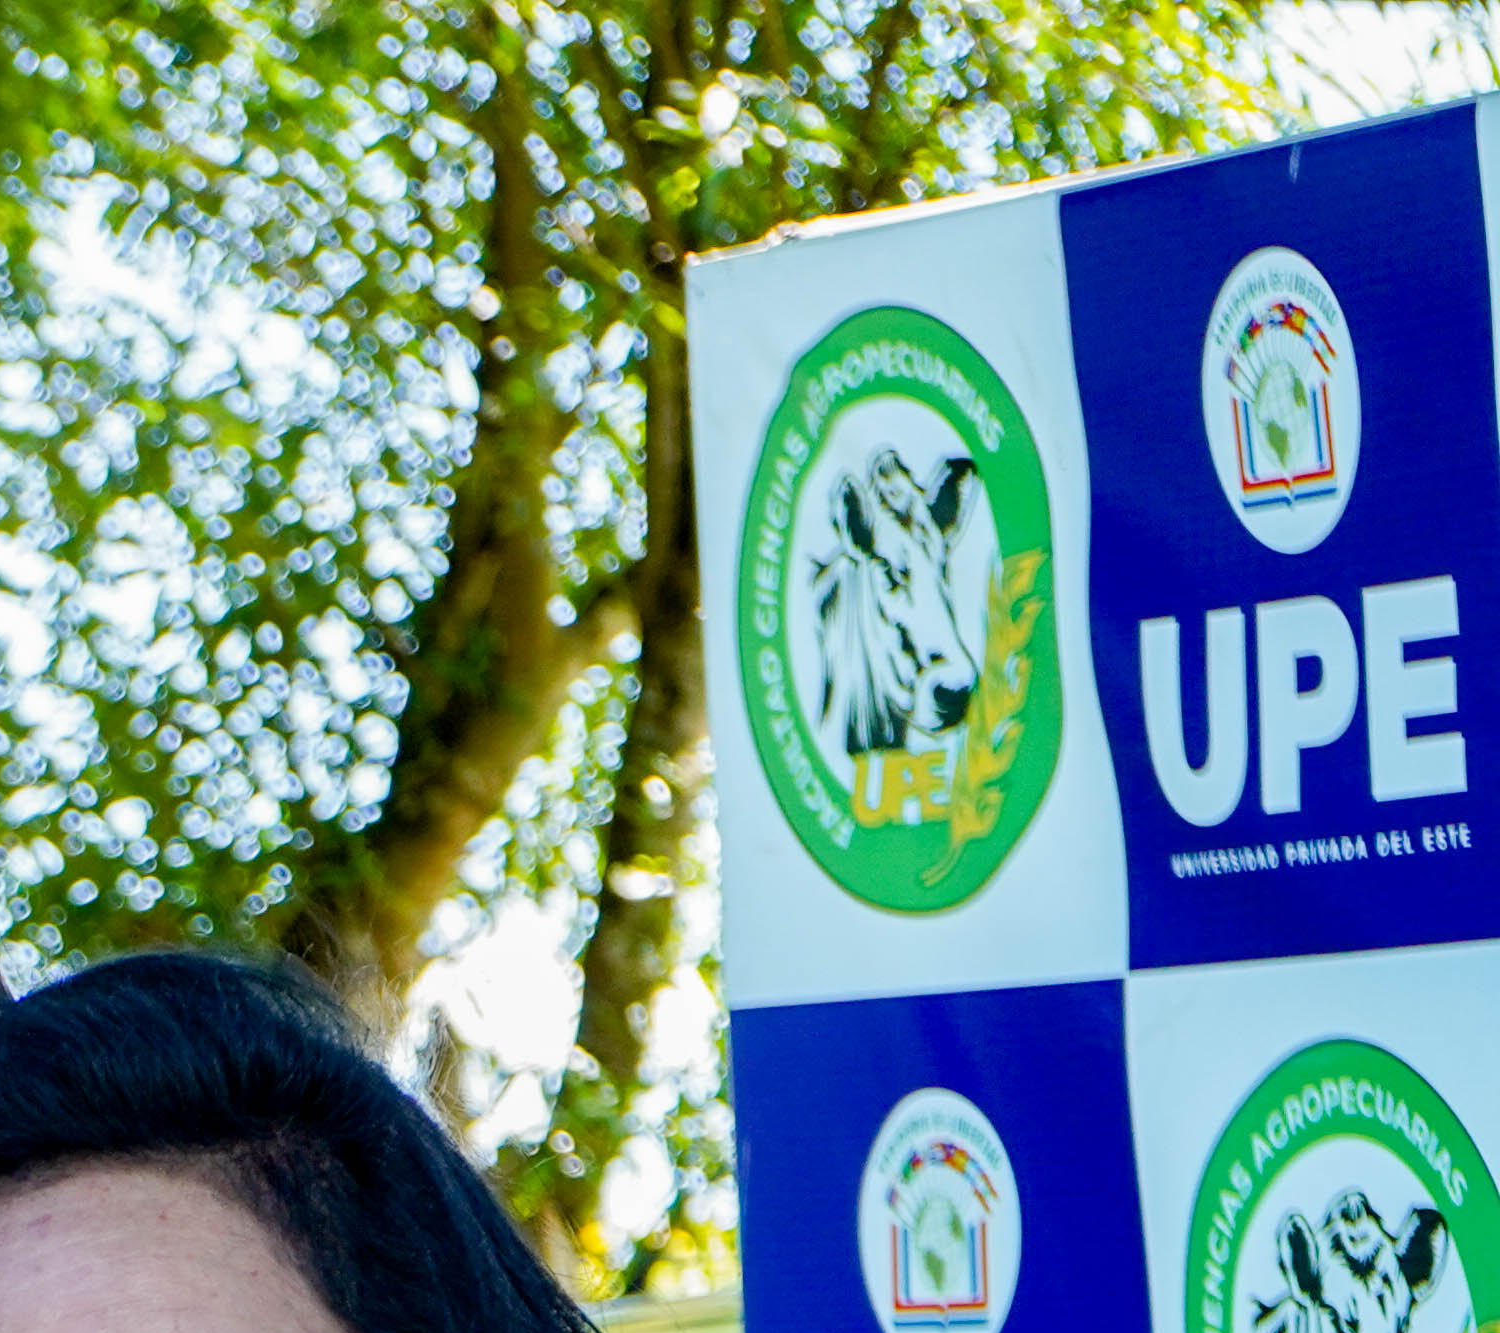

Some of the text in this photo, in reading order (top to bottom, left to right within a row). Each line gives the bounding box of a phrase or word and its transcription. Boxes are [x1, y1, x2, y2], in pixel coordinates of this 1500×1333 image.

[754, 341, 1004, 850] FACULTAD CIENCIAS AGROPECUARIAS
[1139, 574, 1468, 827] UPE
[852, 748, 952, 828] UPE
[1171, 822, 1472, 878] UNIVERSIDAD PRIVADA DEL ESTE
[1249, 1076, 1468, 1207] AGROPECUARIAS
